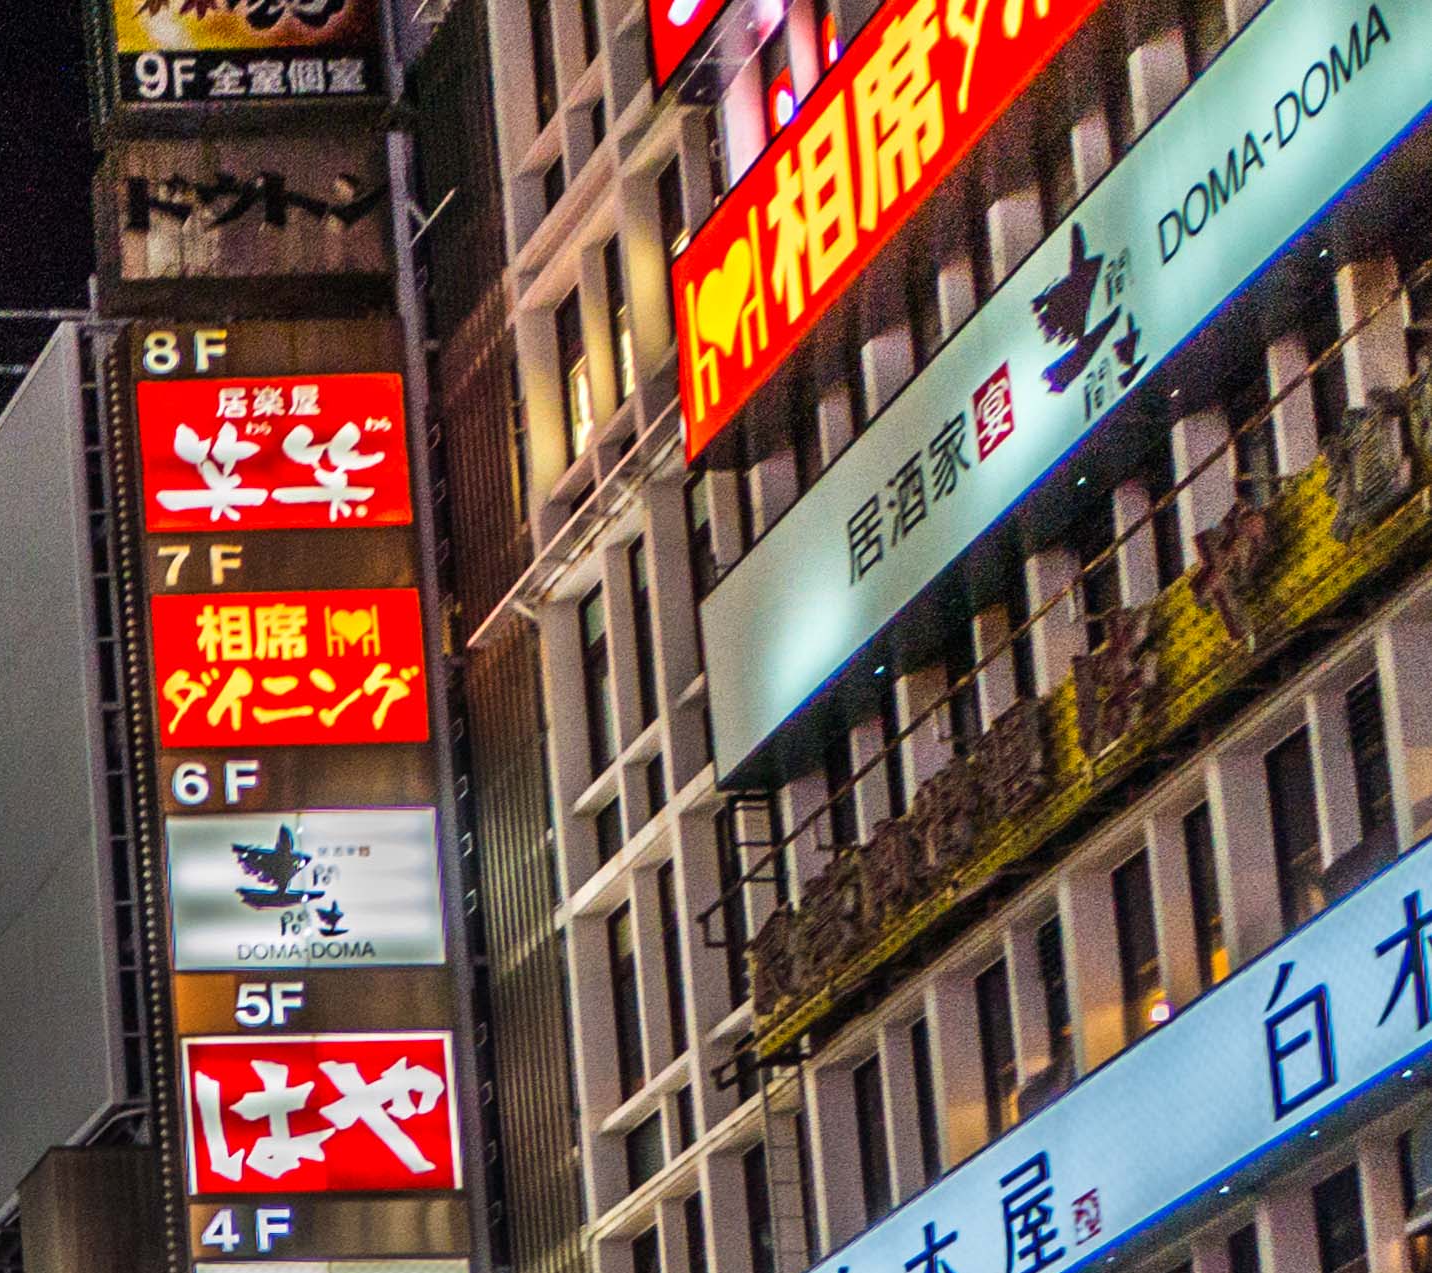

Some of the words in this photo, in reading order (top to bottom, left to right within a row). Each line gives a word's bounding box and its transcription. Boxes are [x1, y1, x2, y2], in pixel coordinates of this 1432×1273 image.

[134, 51, 197, 100] 9F
[207, 57, 366, 97] 全室個室
[1157, 7, 1392, 267] DOMA-DOMA
[214, 385, 322, 418] 居楽屋
[846, 412, 974, 586] 居酒家
[195, 602, 309, 663] 相席
[163, 659, 422, 734] ダイニング
[235, 938, 377, 962] DOMA-DOMA
[234, 981, 305, 1028] 5F
